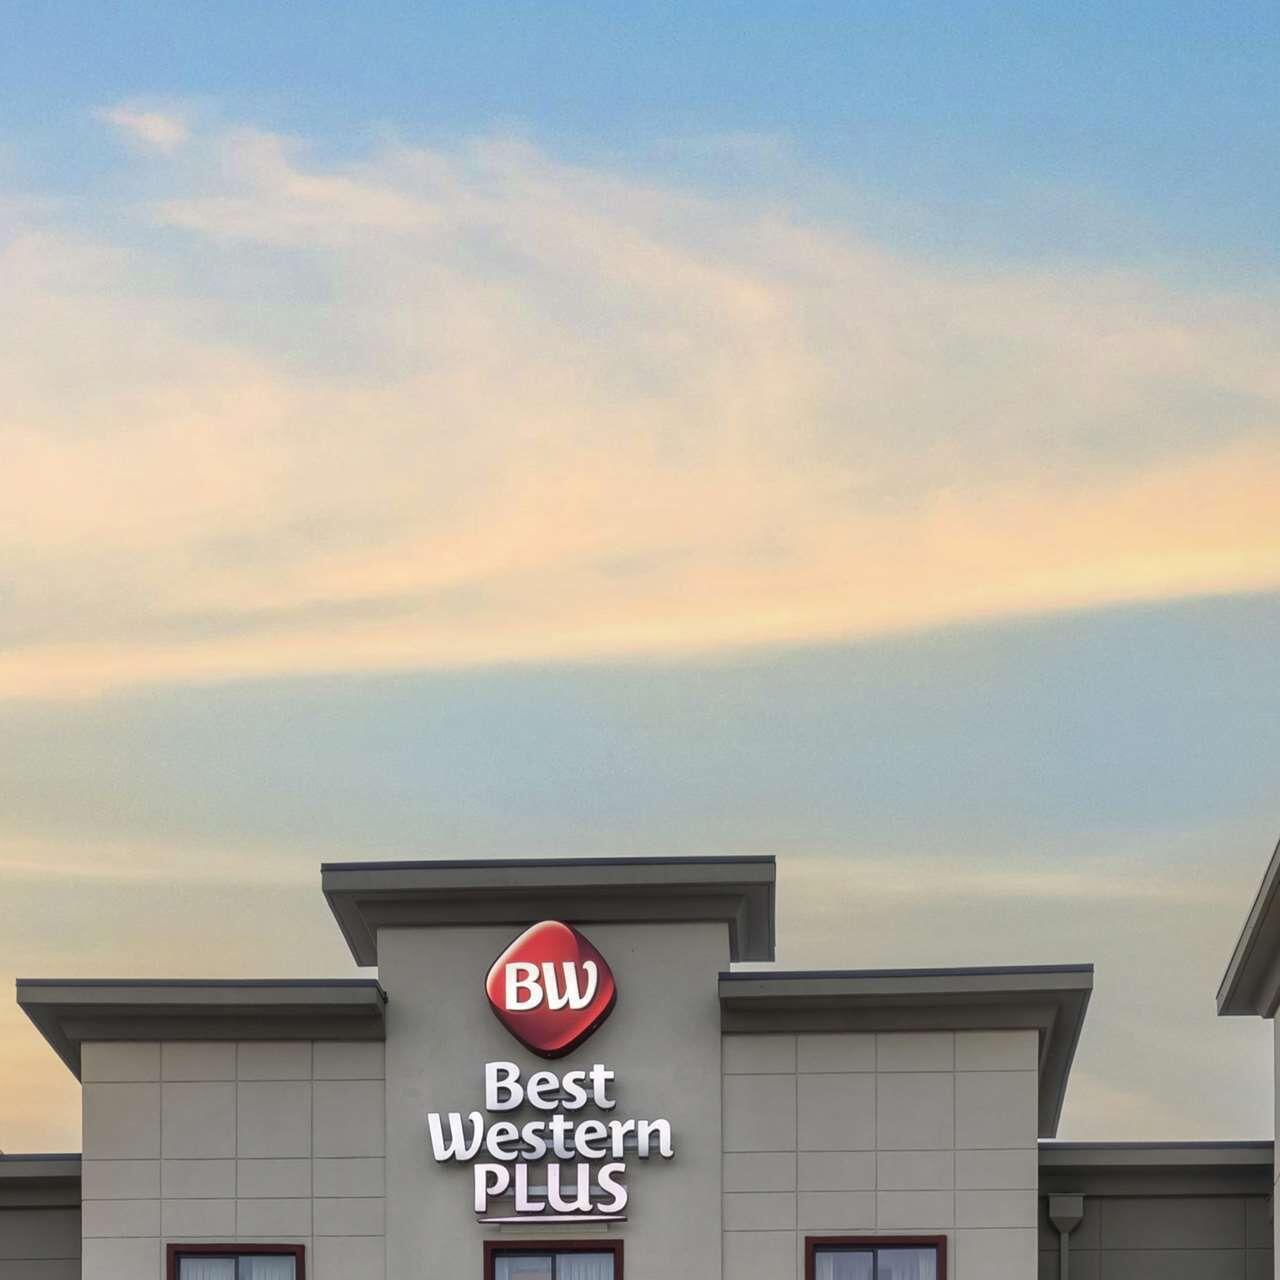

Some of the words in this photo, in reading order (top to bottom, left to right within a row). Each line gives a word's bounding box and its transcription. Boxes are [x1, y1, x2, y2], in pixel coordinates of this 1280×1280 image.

[504, 961, 598, 1011] BW
[485, 1062, 616, 1111] Best
[427, 1112, 674, 1161] Western
[474, 1163, 628, 1213] PLUS
